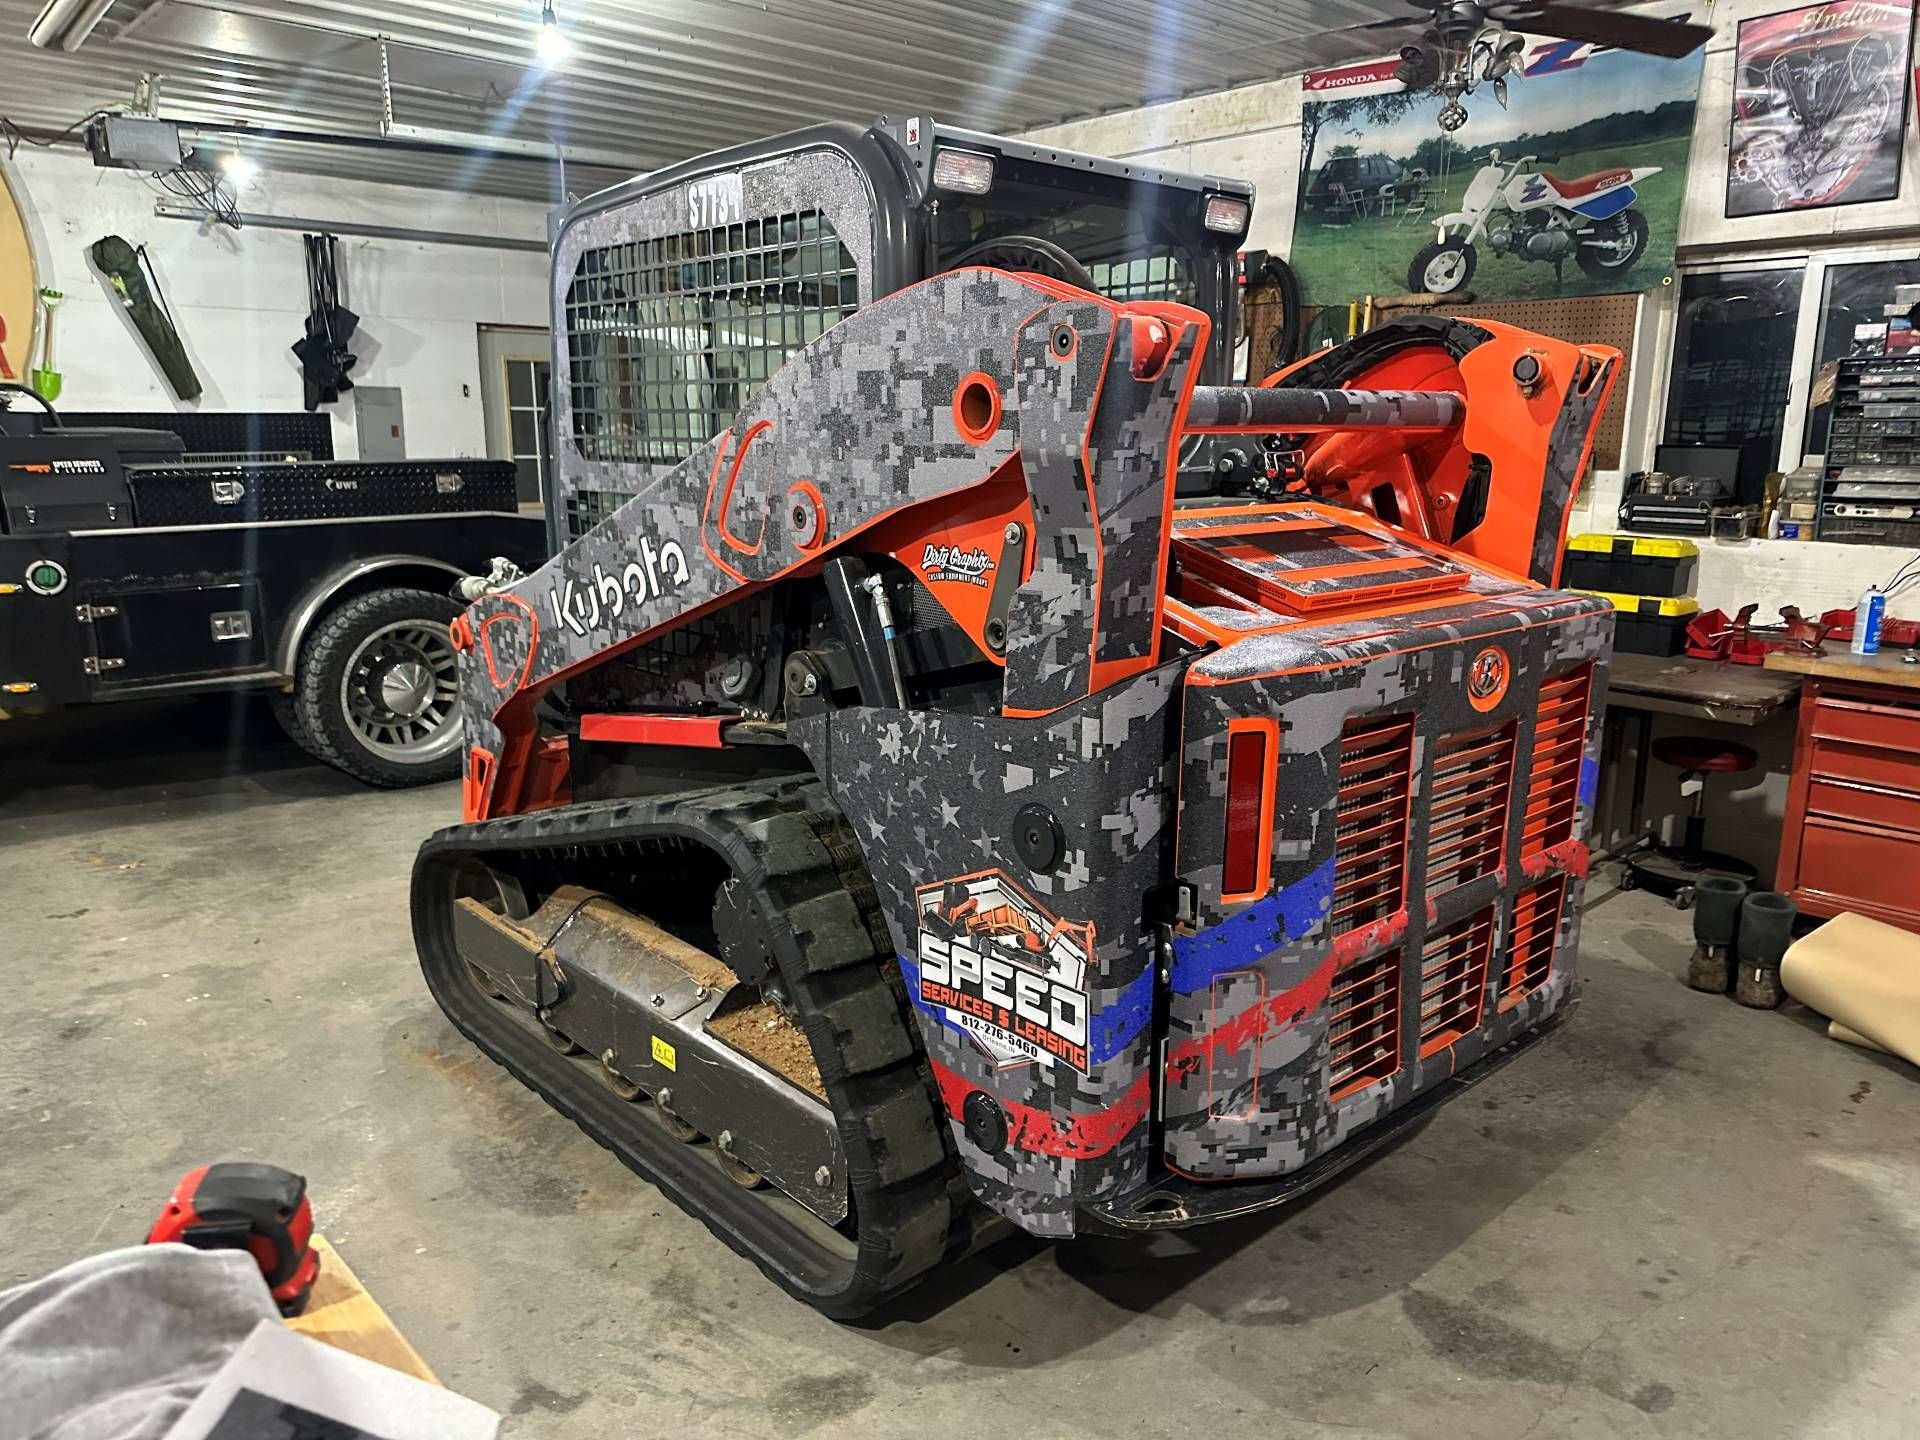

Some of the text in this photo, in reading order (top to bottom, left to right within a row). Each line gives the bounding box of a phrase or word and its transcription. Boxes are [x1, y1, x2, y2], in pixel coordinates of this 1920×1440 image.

[1795, 2, 1889, 32] Indian
[1326, 73, 1377, 88] HONDA
[335, 480, 358, 490] UWS
[923, 544, 949, 569] Dirty
[549, 536, 690, 636] Kubota
[927, 573, 988, 587] CUSTOM EQUIPMENT WRAPS
[921, 933, 1087, 1047] SPEED
[921, 980, 993, 1021] SERVICES
[1014, 1016, 1087, 1070] LEASING
[961, 1014, 1038, 1058] 812-276-5460
